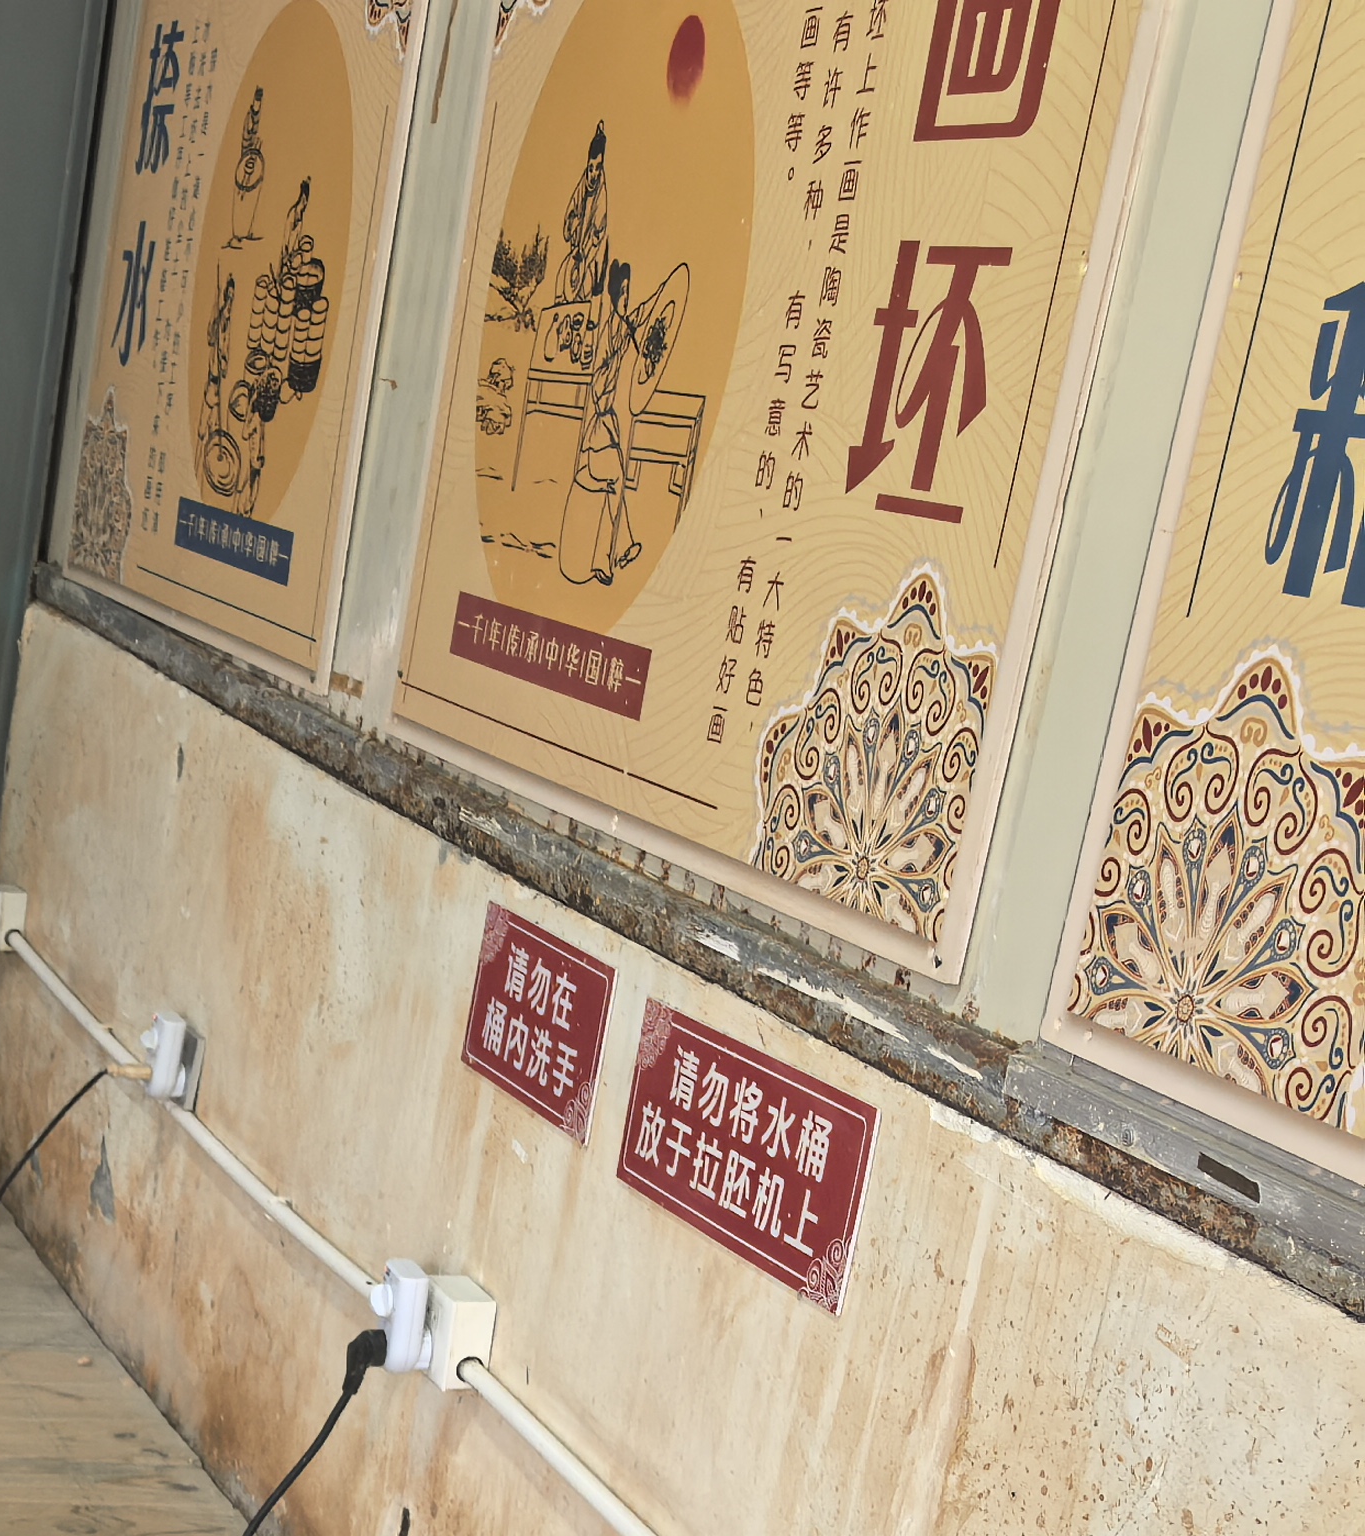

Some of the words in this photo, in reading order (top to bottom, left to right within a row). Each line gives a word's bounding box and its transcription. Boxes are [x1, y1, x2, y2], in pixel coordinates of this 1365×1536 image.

[471, 612, 626, 693] 千年传承中华国粹
[503, 942, 578, 1030] 请勿在
[481, 996, 581, 1098] 桶内洗手
[668, 1045, 834, 1183] 请勿将水桶
[634, 1101, 819, 1258] 放于拉胚机上
